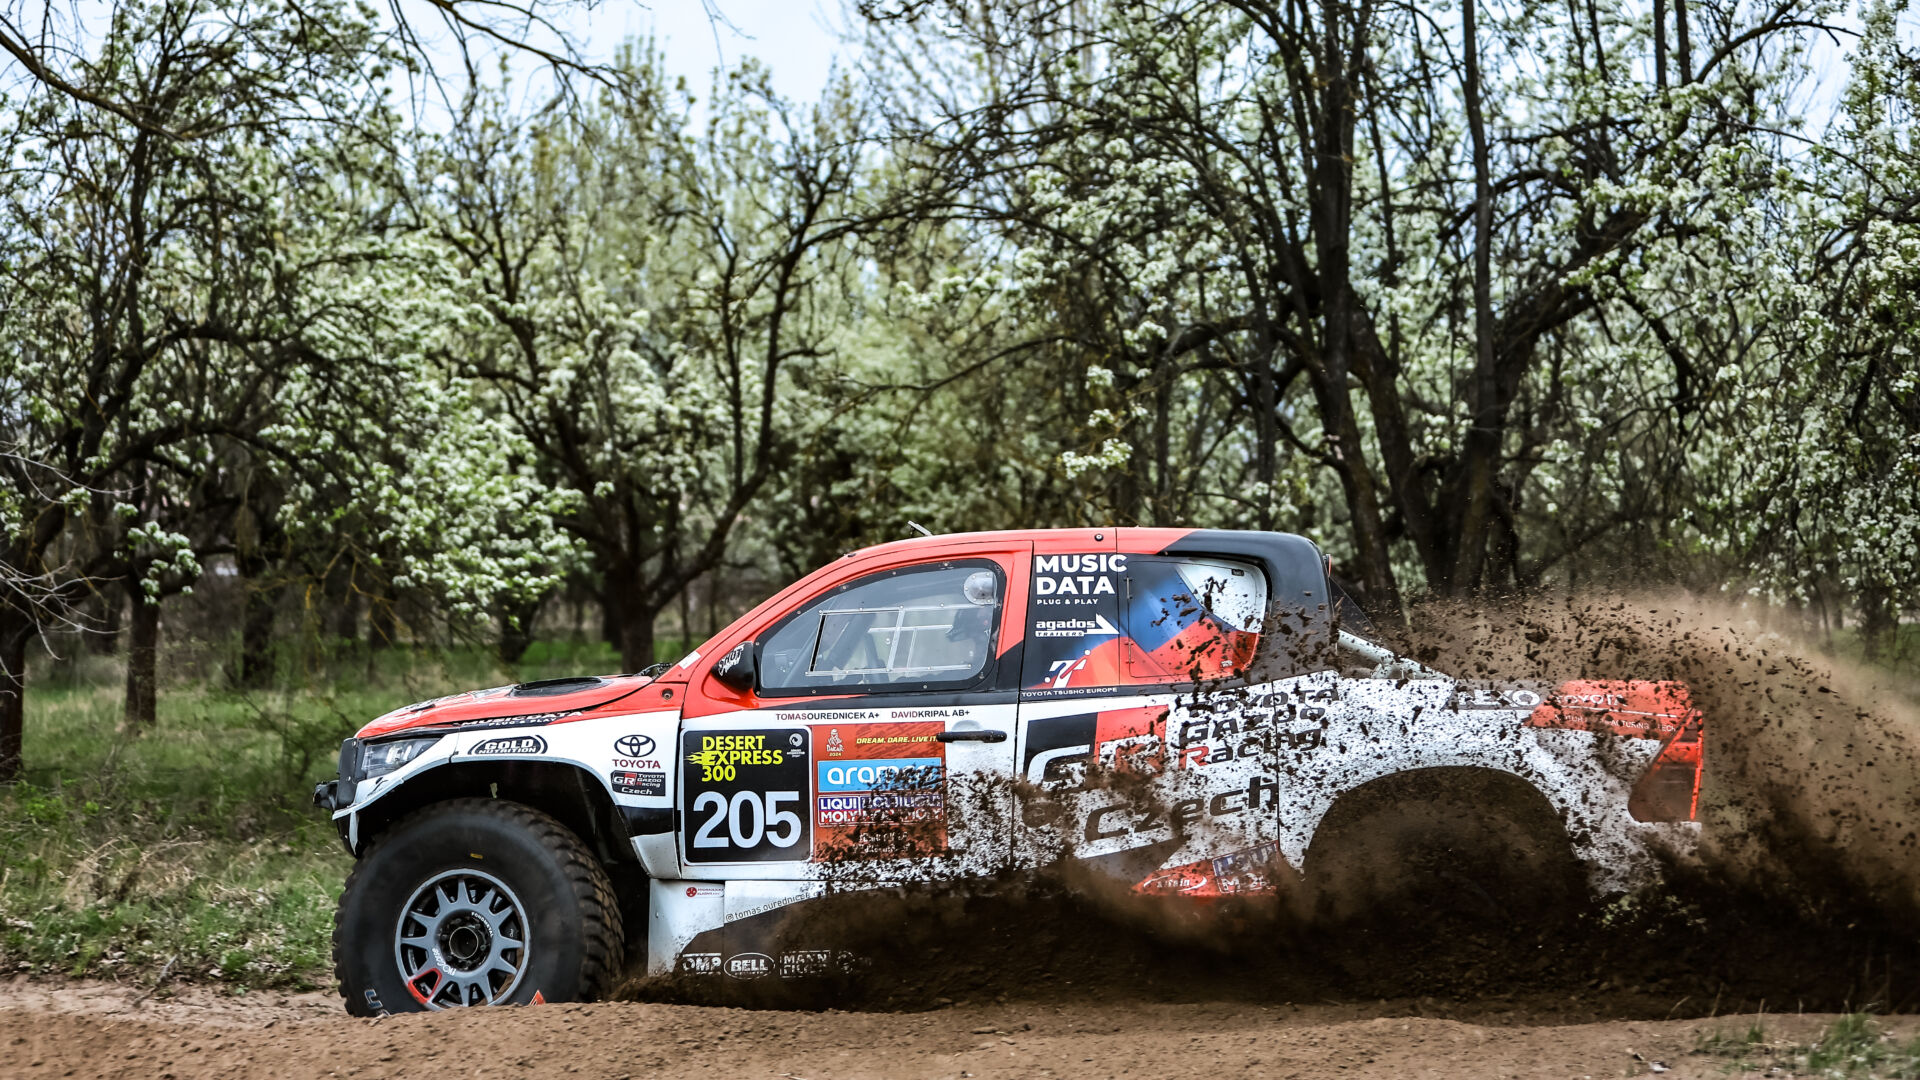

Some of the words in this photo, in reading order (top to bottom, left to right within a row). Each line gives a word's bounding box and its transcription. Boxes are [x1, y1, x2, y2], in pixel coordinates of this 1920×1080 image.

[1035, 554, 1128, 573] MUSIC
[1036, 576, 1116, 595] DATA
[1035, 619, 1096, 631] agados
[1021, 690, 1052, 698] TOYOTA
[1053, 688, 1085, 696] TSUSHO
[867, 712, 880, 720] A+
[891, 709, 950, 719] DAVIDKRIPAL
[952, 709, 970, 717] AB+
[484, 739, 535, 750] GOLD
[702, 735, 766, 751] DESERT
[856, 737, 886, 745] DREAM.
[887, 736, 910, 744] DARE.
[478, 747, 537, 755] NUTRITION
[612, 759, 662, 769] TOYOTA
[701, 750, 784, 766] EXPRESS
[701, 765, 737, 782] 300
[613, 776, 635, 786] GR
[621, 786, 653, 795] Czech
[820, 797, 857, 810] LIQUI
[1084, 776, 1279, 842] Czech
[692, 790, 802, 849] 205
[820, 810, 858, 822] MOLY
[682, 957, 722, 972] OMP
[730, 959, 769, 973] BELL
